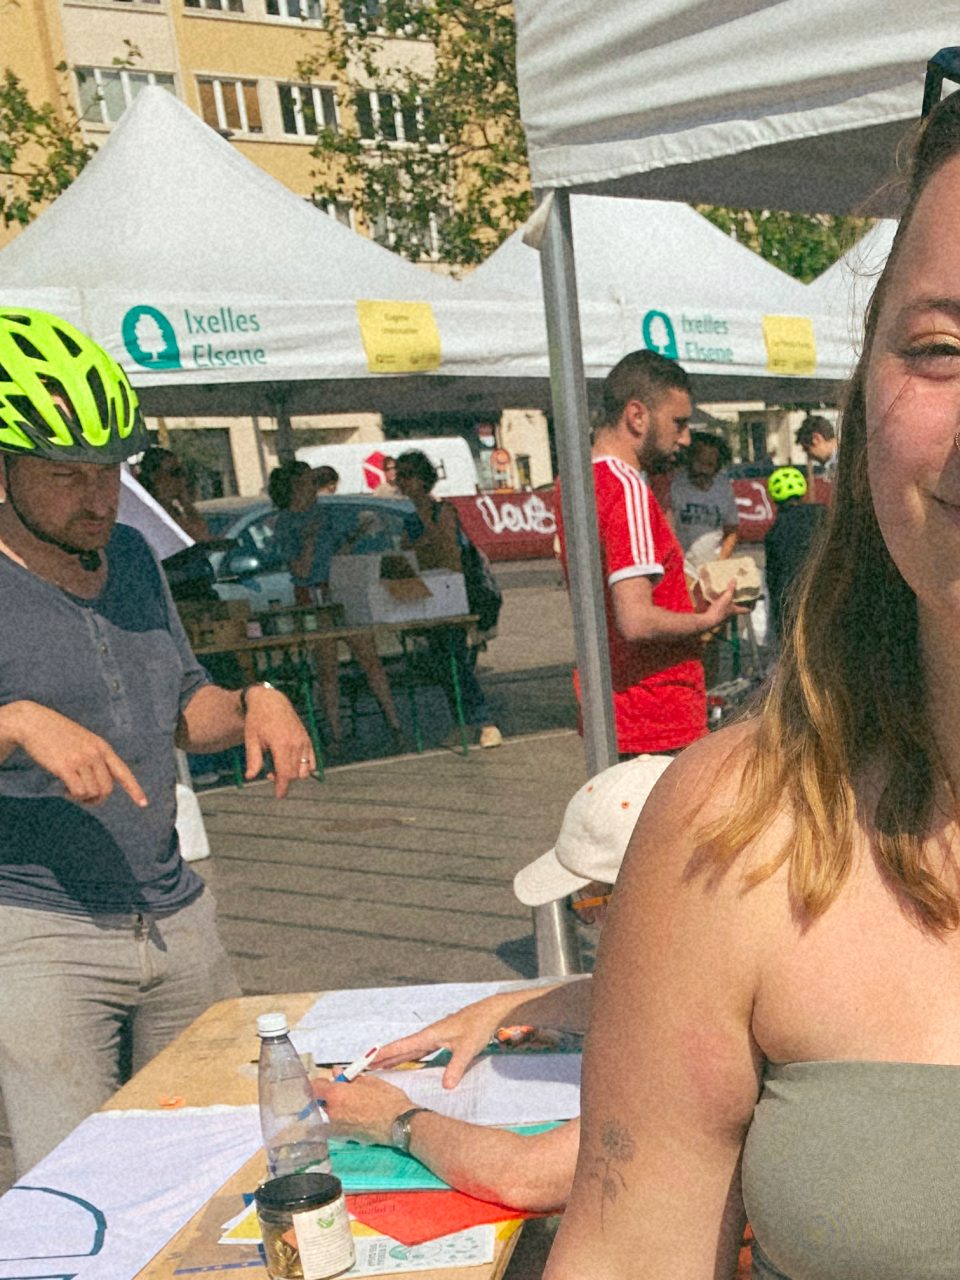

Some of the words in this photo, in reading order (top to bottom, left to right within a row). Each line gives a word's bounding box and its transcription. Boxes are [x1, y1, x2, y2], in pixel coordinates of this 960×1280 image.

[184, 307, 260, 334] Ixelles
[681, 313, 729, 335] Ixelles
[192, 345, 267, 368] Elsene
